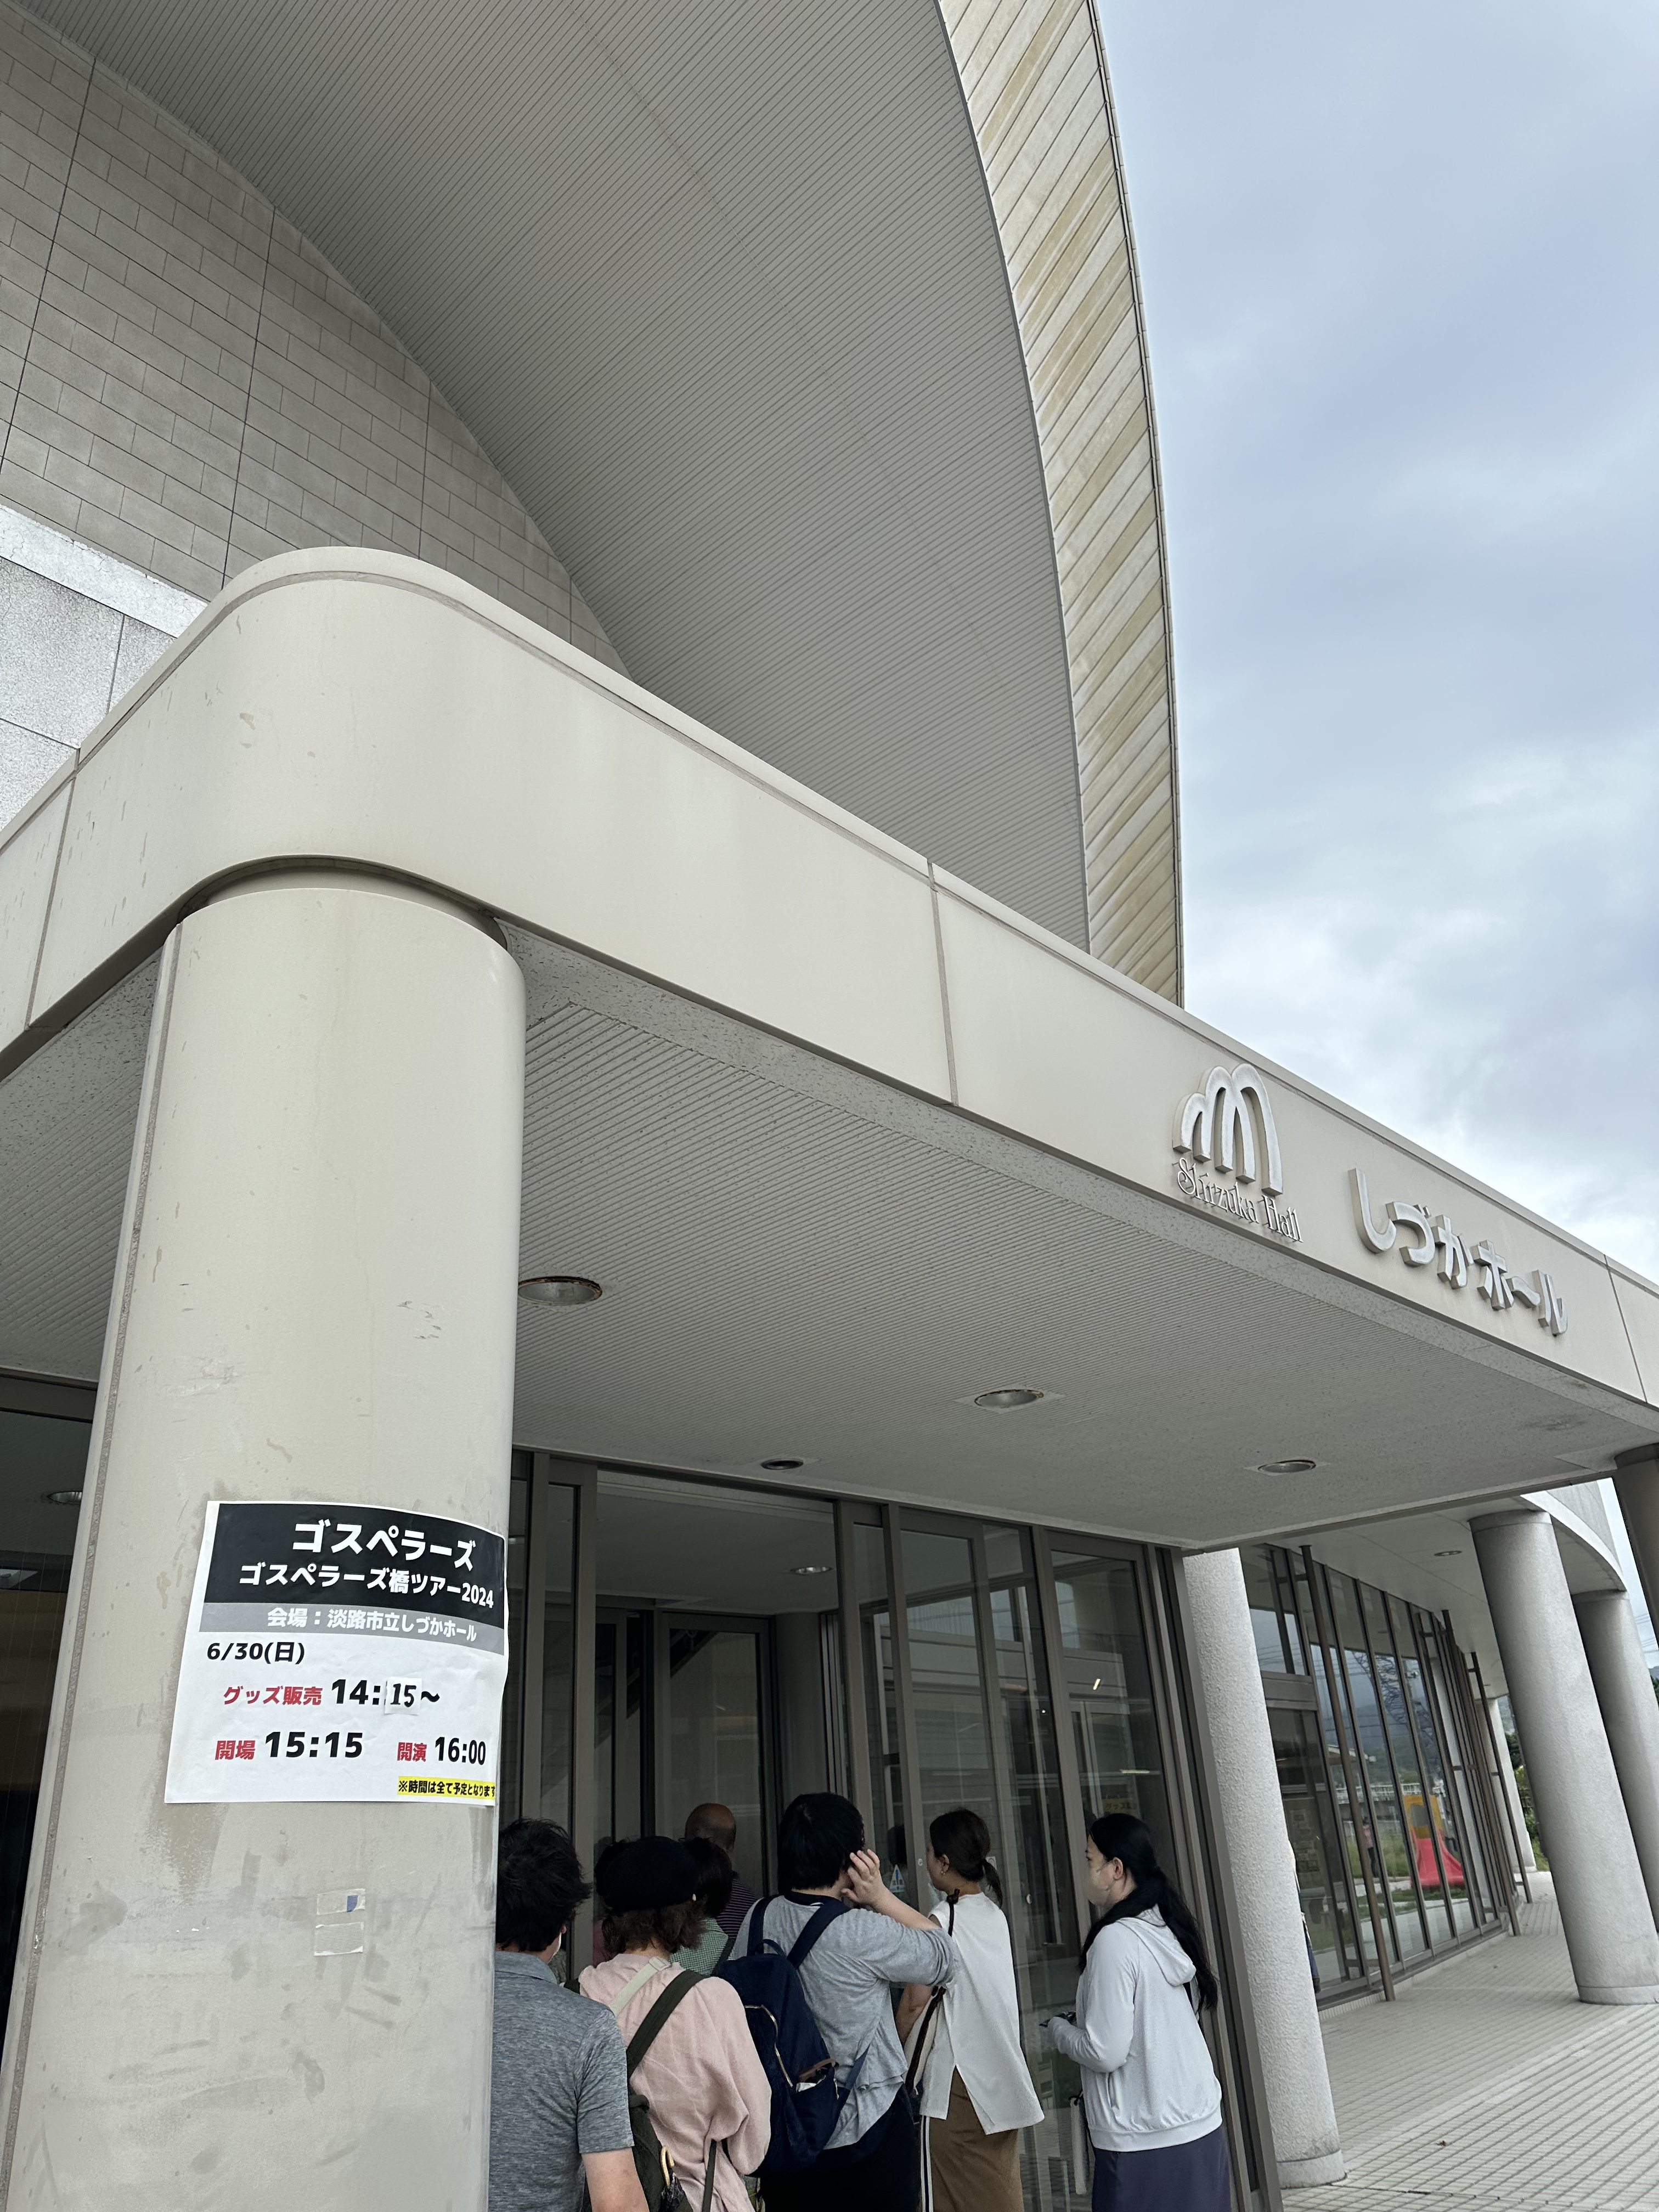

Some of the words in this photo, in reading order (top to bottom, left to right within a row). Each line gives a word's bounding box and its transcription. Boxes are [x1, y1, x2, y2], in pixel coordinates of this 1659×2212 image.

[1177, 1157, 1260, 1224] Shizuka
[1261, 1194, 1304, 1243] Hall
[1347, 1166, 1568, 1336] しづかホール
[292, 1519, 476, 1571] ゴスペラーズ
[239, 1561, 495, 1609] ゴスペラーズ橋ツアー2024
[206, 1642, 306, 1664] 6/30(日)
[223, 1685, 323, 1706] グッズ販売
[215, 1740, 256, 1760] 開場
[265, 1731, 364, 1758] 15:15
[397, 1742, 427, 1762] 開演
[435, 1736, 487, 1765] 16:00
